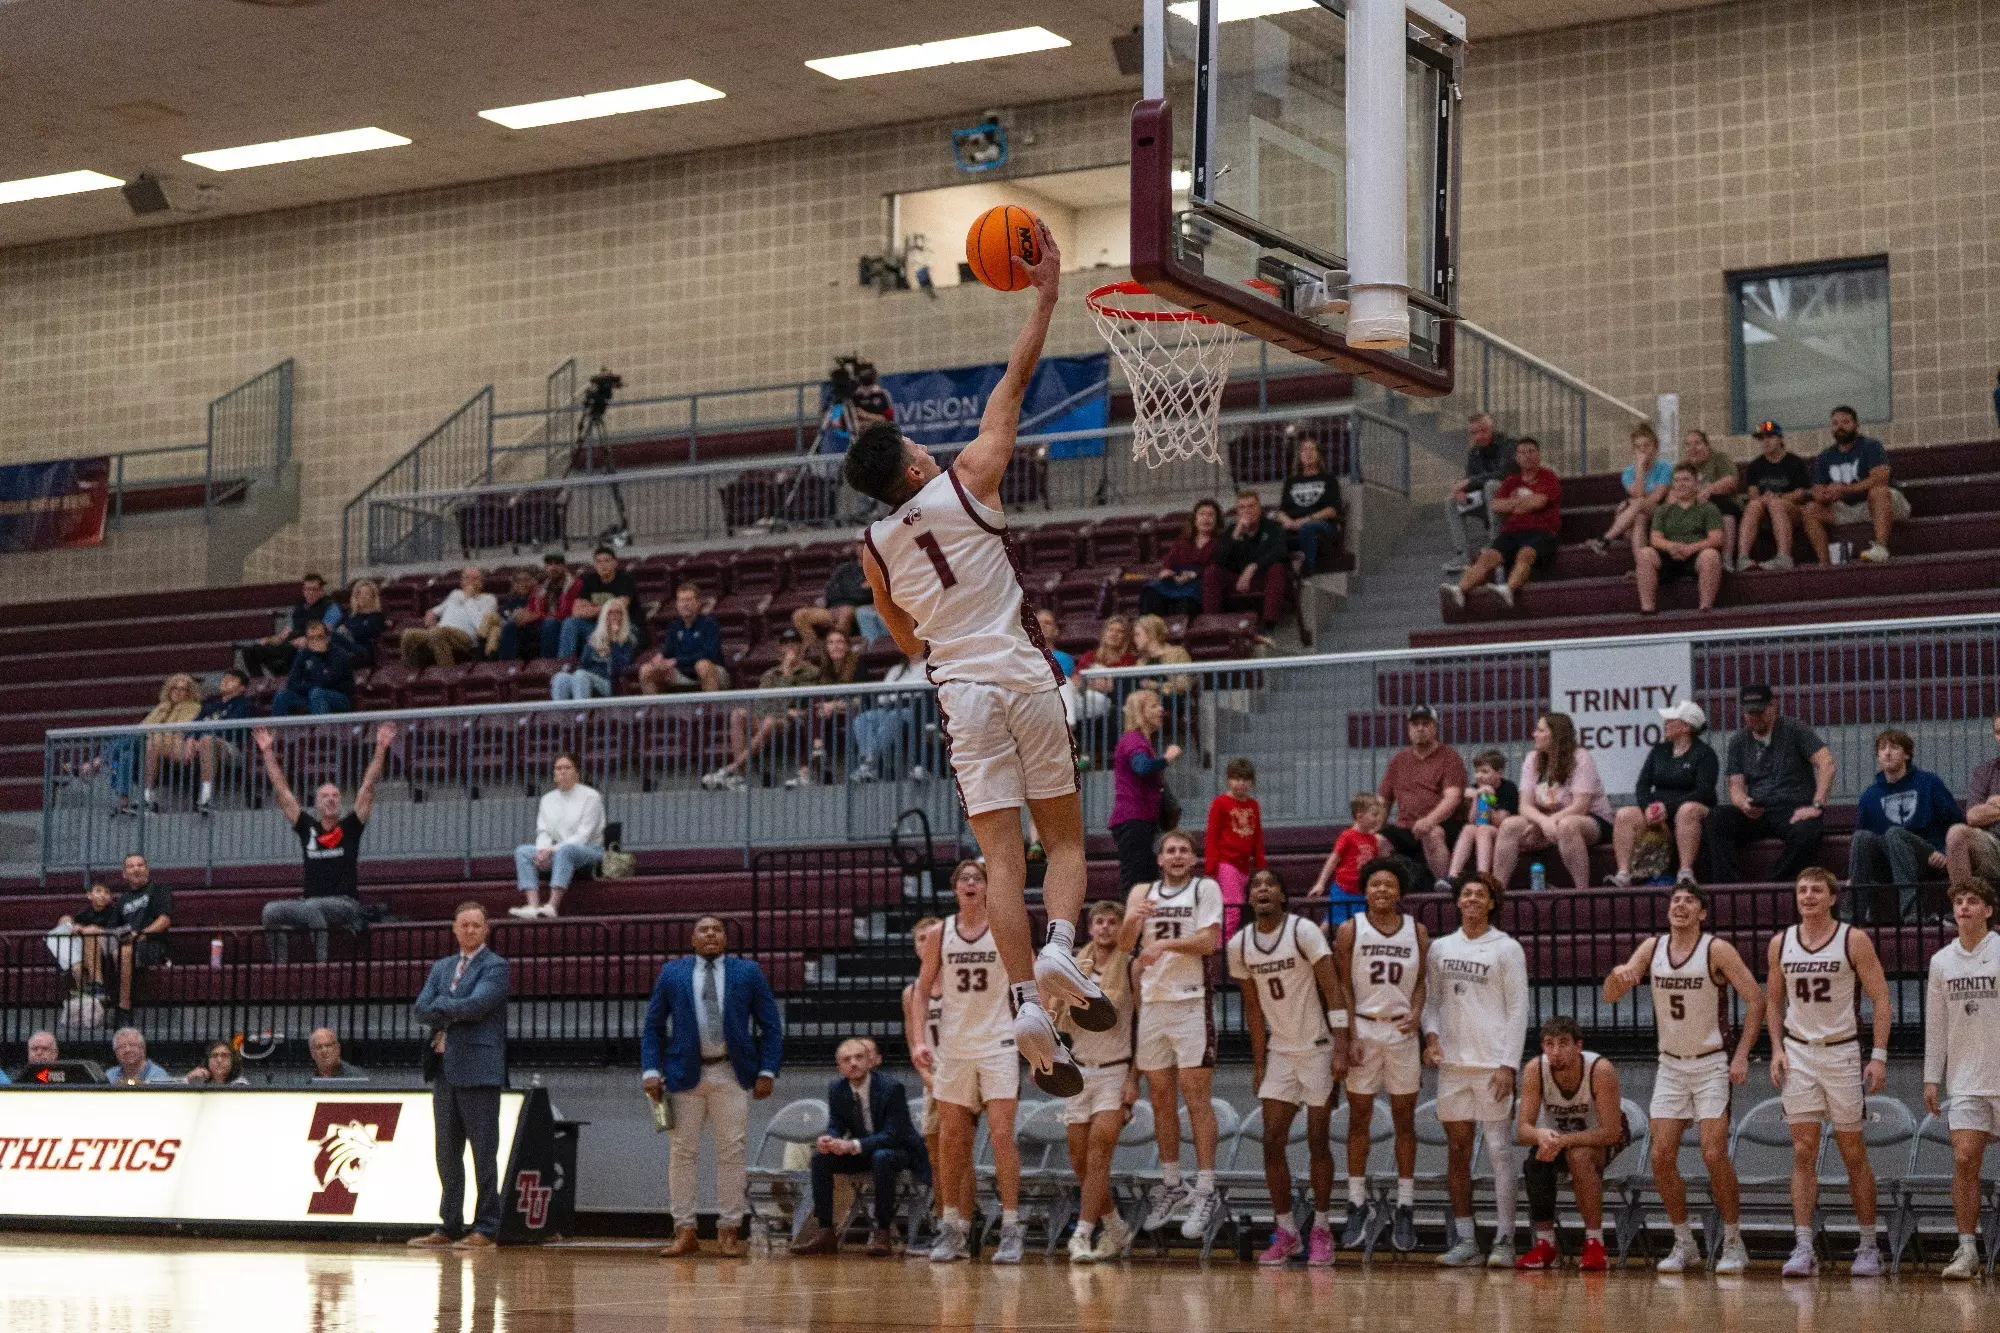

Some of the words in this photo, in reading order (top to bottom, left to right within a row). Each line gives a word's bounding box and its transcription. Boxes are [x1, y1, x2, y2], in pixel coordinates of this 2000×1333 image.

[894, 396, 979, 423] IVISION
[914, 530, 957, 590] 1
[1565, 685, 1677, 713] TRINITY
[1579, 723, 1662, 750] ECTIO
[1154, 921, 1182, 941] 21
[947, 951, 997, 965] TIGERS
[1361, 944, 1412, 959] TIGERS
[1249, 957, 1295, 974] TIGERS
[1370, 961, 1404, 985] 20
[1443, 958, 1491, 976] TRINITY
[1783, 961, 1840, 974] TIGERS
[956, 968, 989, 993] 33
[1268, 977, 1285, 1001] 0
[1654, 975, 1704, 990] TIGERS
[1795, 977, 1832, 1003] 42
[1947, 976, 1996, 992] TRINITY
[1669, 994, 1686, 1021] 5
